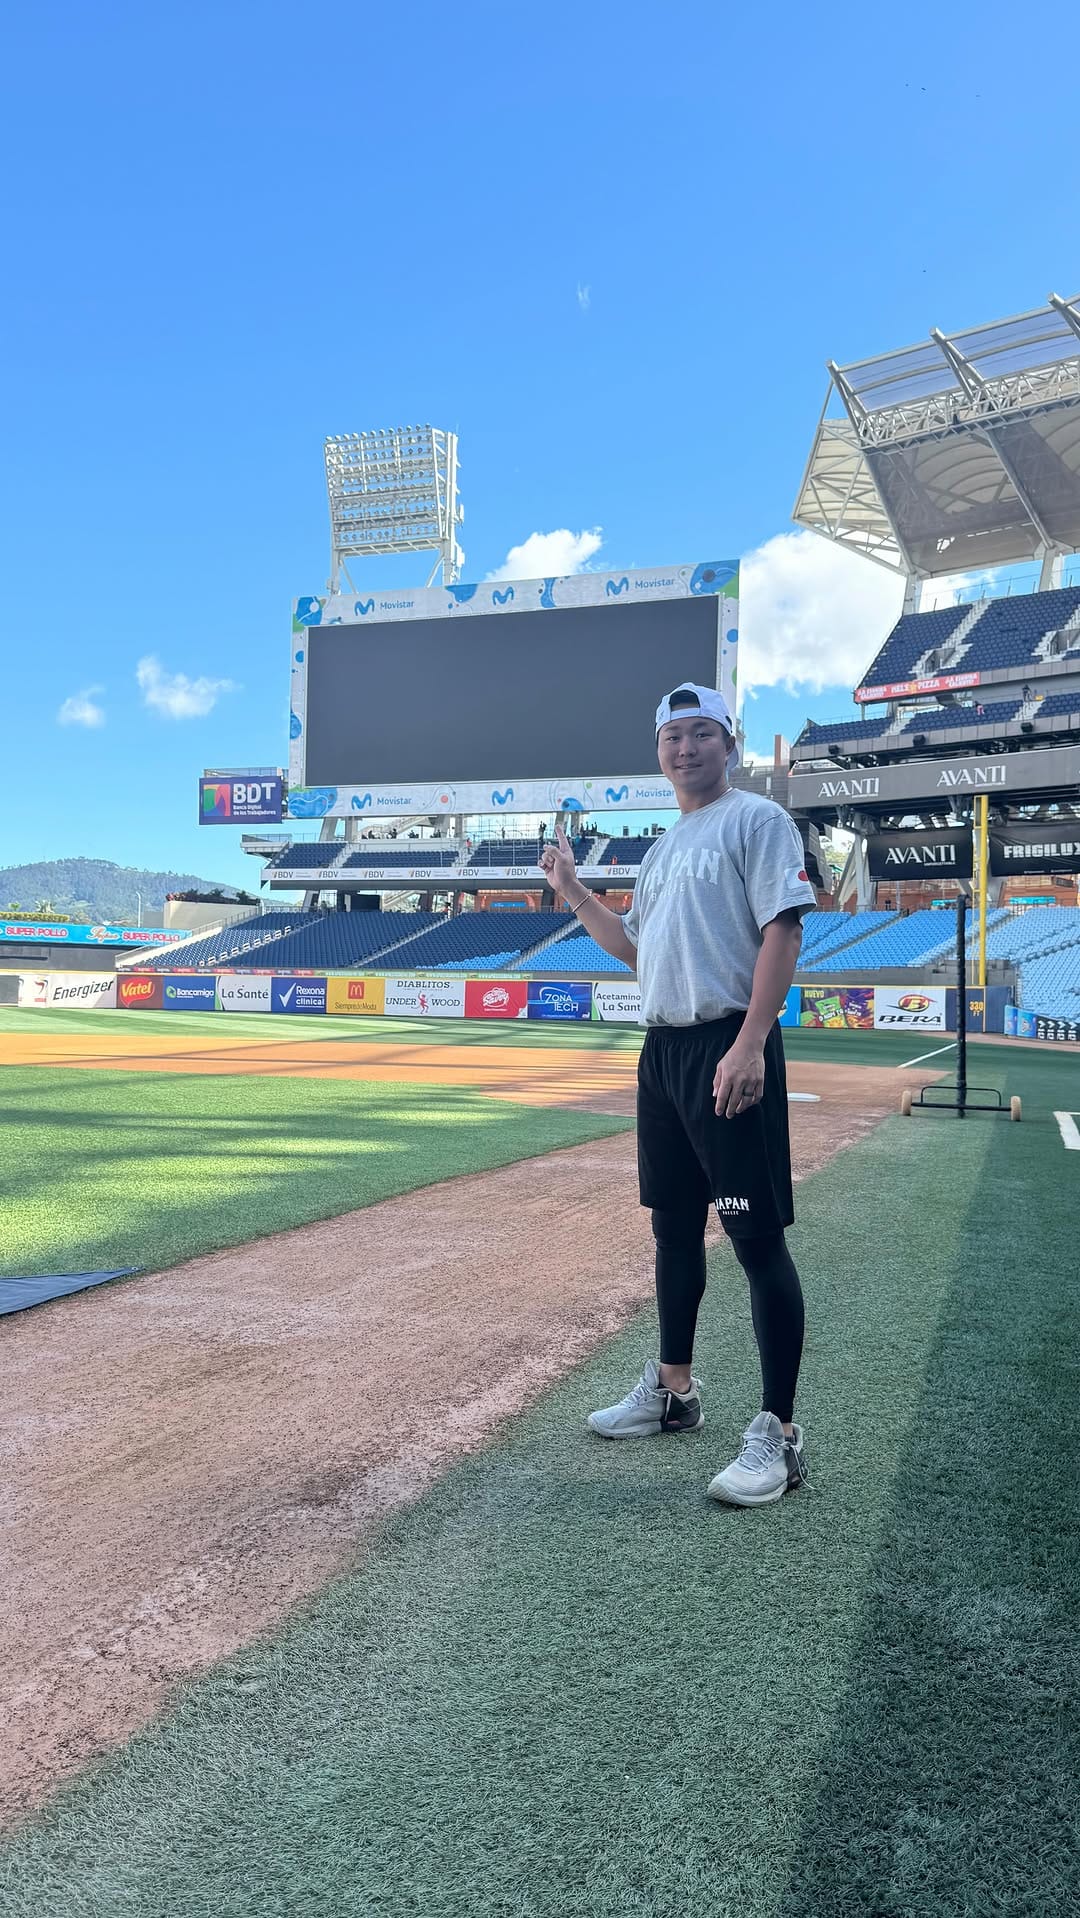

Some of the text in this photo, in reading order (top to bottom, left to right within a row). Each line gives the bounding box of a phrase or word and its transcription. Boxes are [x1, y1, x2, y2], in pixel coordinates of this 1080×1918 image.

[634, 577, 675, 589] Movistar
[379, 599, 415, 611] Movistar
[937, 765, 1007, 788] AVANTI
[818, 777, 879, 798] AVANTI
[232, 783, 276, 804] BDT
[377, 797, 412, 806] Movistar
[885, 844, 956, 866] AVANTI
[277, 871, 294, 879] BDV
[368, 870, 385, 878] BDV
[414, 870, 432, 878] BDV
[462, 869, 479, 877] BDV
[511, 868, 528, 877] BDV
[612, 867, 630, 876] BDV
[6, 927, 68, 937] SUPER POLLO
[122, 932, 150, 941] SUPER
[152, 933, 180, 942] POLLO
[121, 981, 153, 998] Vatel
[397, 980, 451, 989] DIABLITOS
[53, 980, 114, 1001] Energizer
[176, 987, 215, 998] Bancamigo
[221, 987, 269, 999] La Santé
[296, 985, 326, 995] Rexona
[296, 997, 325, 1006] clinical
[385, 997, 461, 1007] UNDER WOOD
[544, 993, 573, 1003] ZONA
[554, 1002, 579, 1012] TECH
[602, 1002, 615, 1012] La
[969, 1001, 984, 1011] 330
[878, 1015, 942, 1023] BERA
